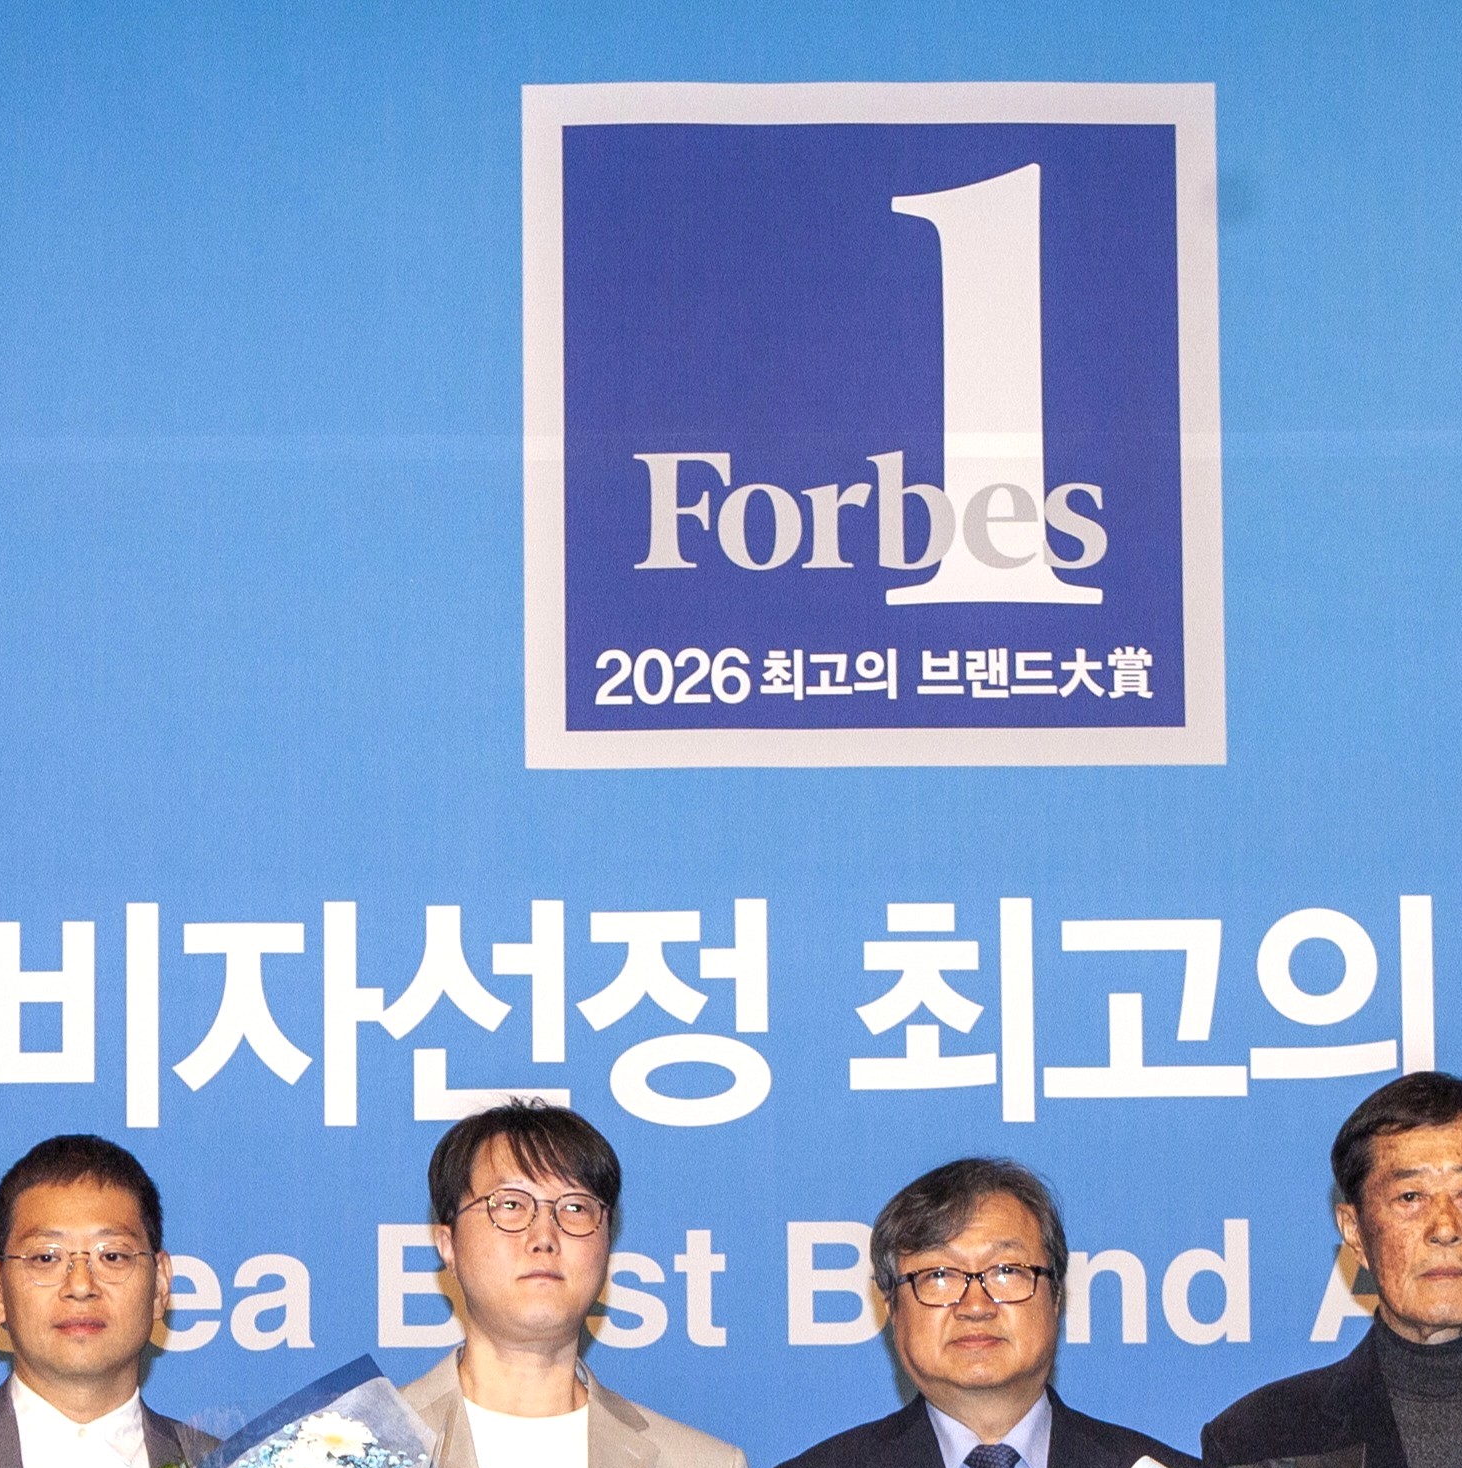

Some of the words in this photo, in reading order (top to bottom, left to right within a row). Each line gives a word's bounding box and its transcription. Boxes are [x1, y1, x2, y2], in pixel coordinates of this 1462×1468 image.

[885, 162, 1104, 606] 1
[632, 449, 1109, 571] Forbes
[593, 646, 752, 707] 2026
[759, 646, 900, 701] 최고의
[915, 645, 1155, 700] 브랜드大賞
[849, 893, 1435, 1123] 최고의
[376, 1223, 728, 1349] Bst
[786, 1217, 1252, 1347] Bnd
